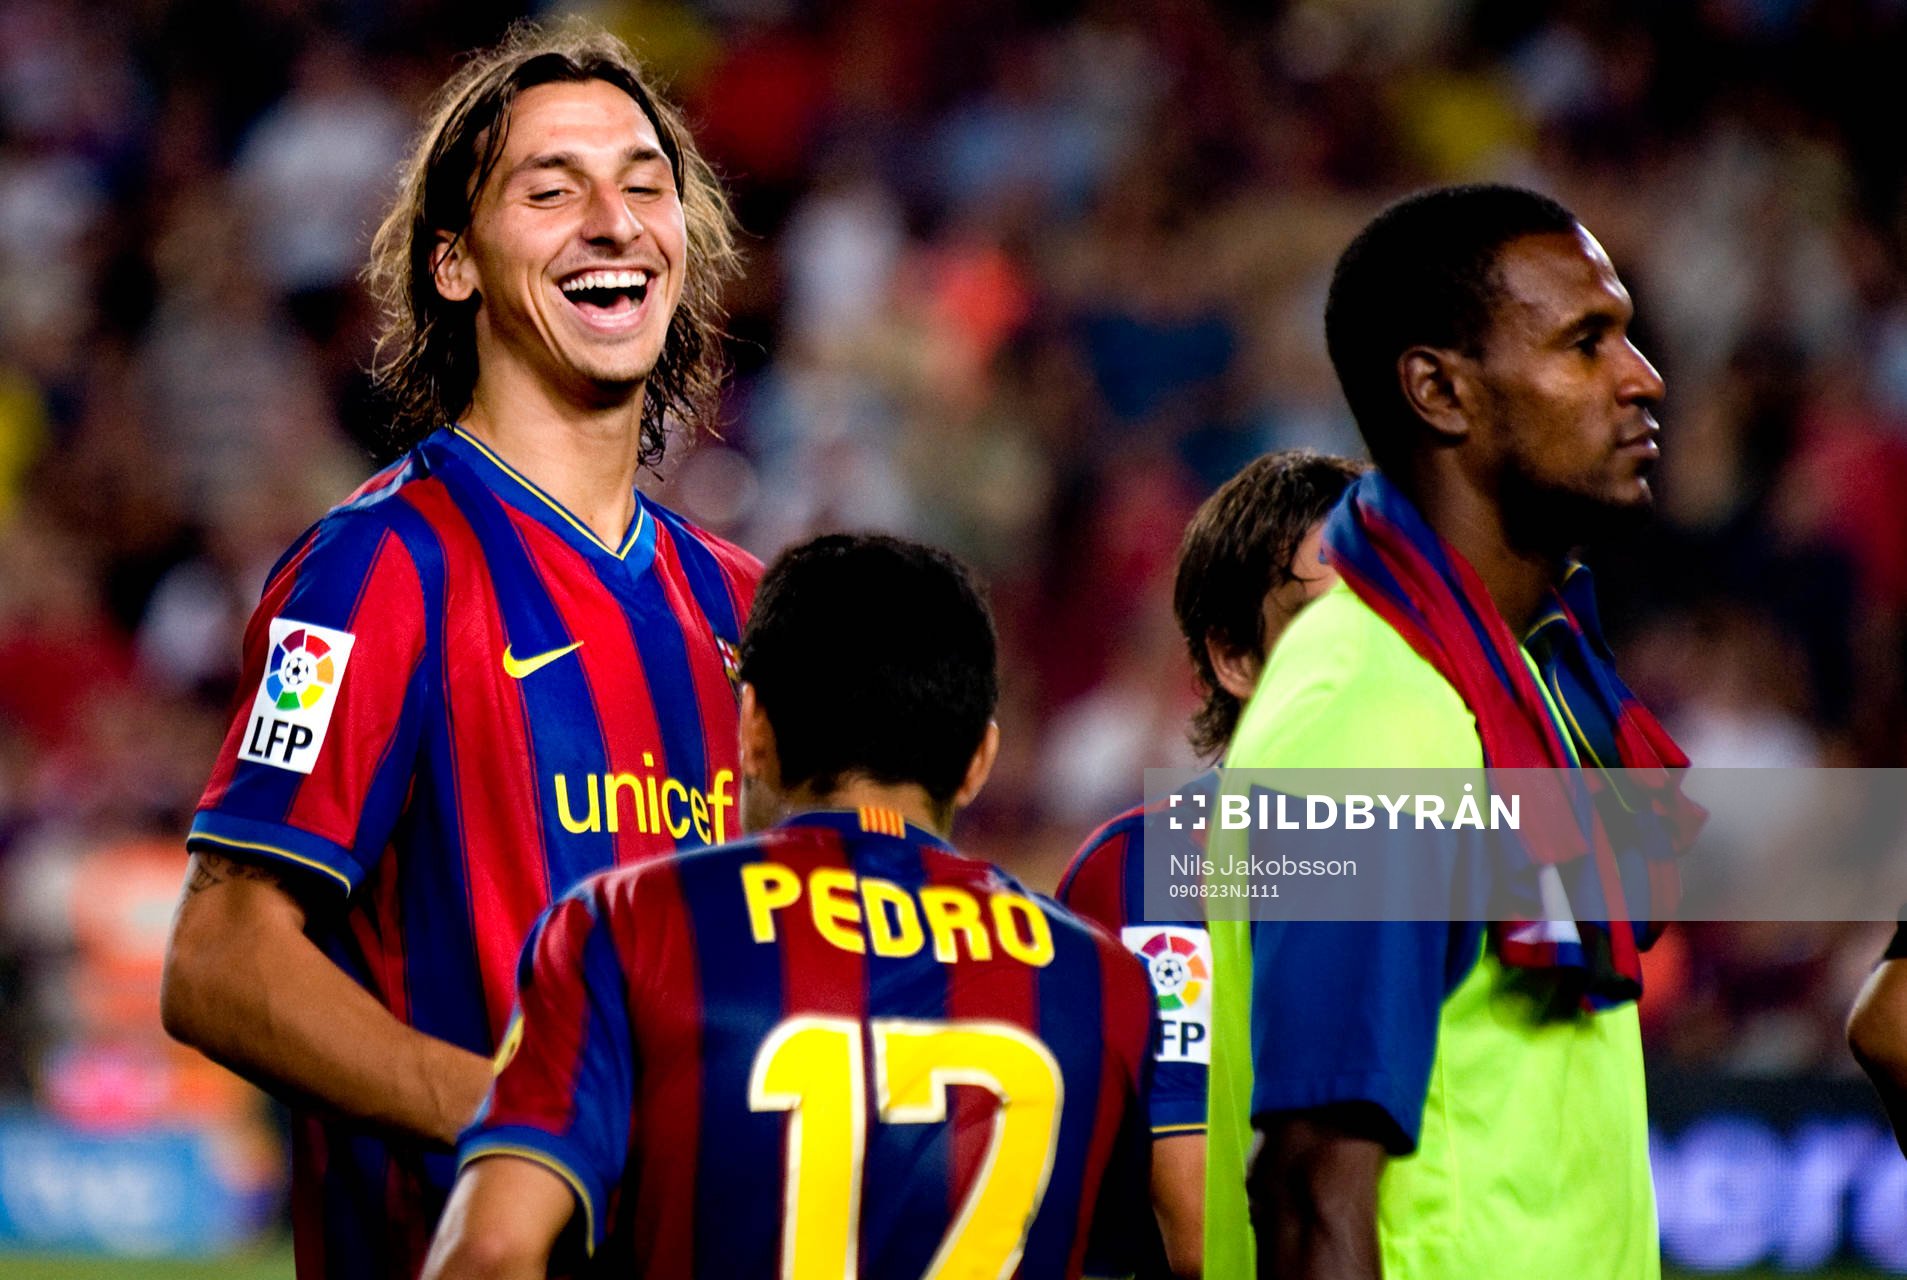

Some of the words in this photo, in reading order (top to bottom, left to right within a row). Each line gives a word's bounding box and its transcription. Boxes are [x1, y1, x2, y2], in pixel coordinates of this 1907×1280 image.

[247, 715, 313, 764] LFP
[554, 752, 734, 846] unicef
[740, 862, 1055, 967] PEDRO
[1155, 1019, 1207, 1057] FP
[748, 1014, 1064, 1280] 17
